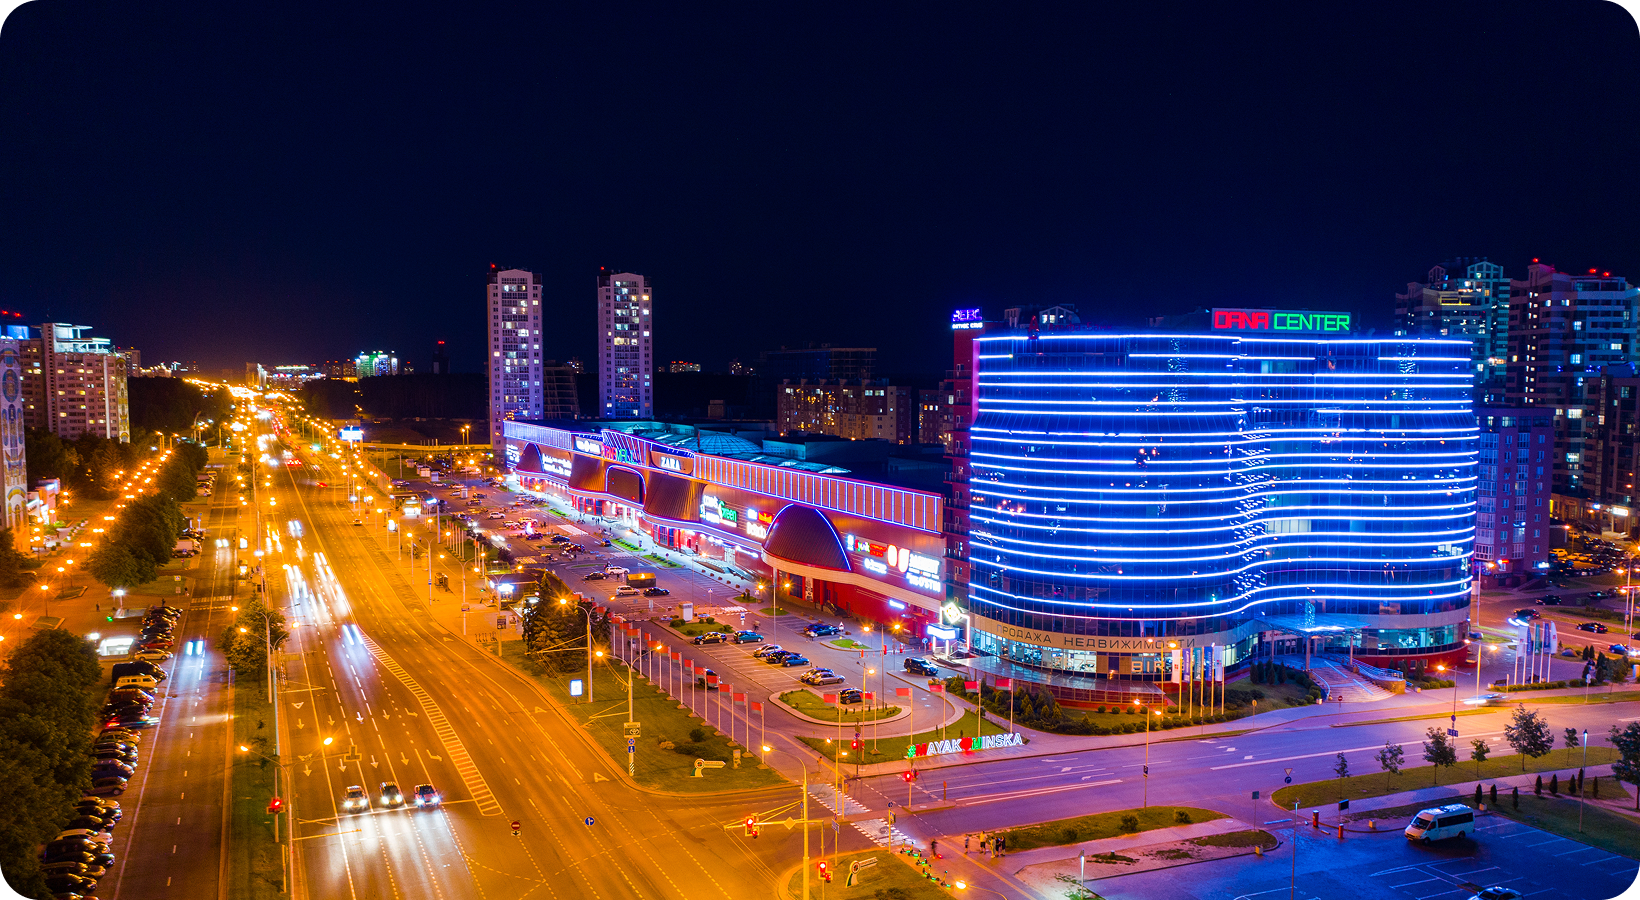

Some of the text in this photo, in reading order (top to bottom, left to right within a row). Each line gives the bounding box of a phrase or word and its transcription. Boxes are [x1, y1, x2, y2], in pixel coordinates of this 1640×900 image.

[1214, 310, 1350, 331] DANA CENTER
[660, 456, 681, 471] ZARA
[996, 624, 1052, 644] ПРОДАЖА
